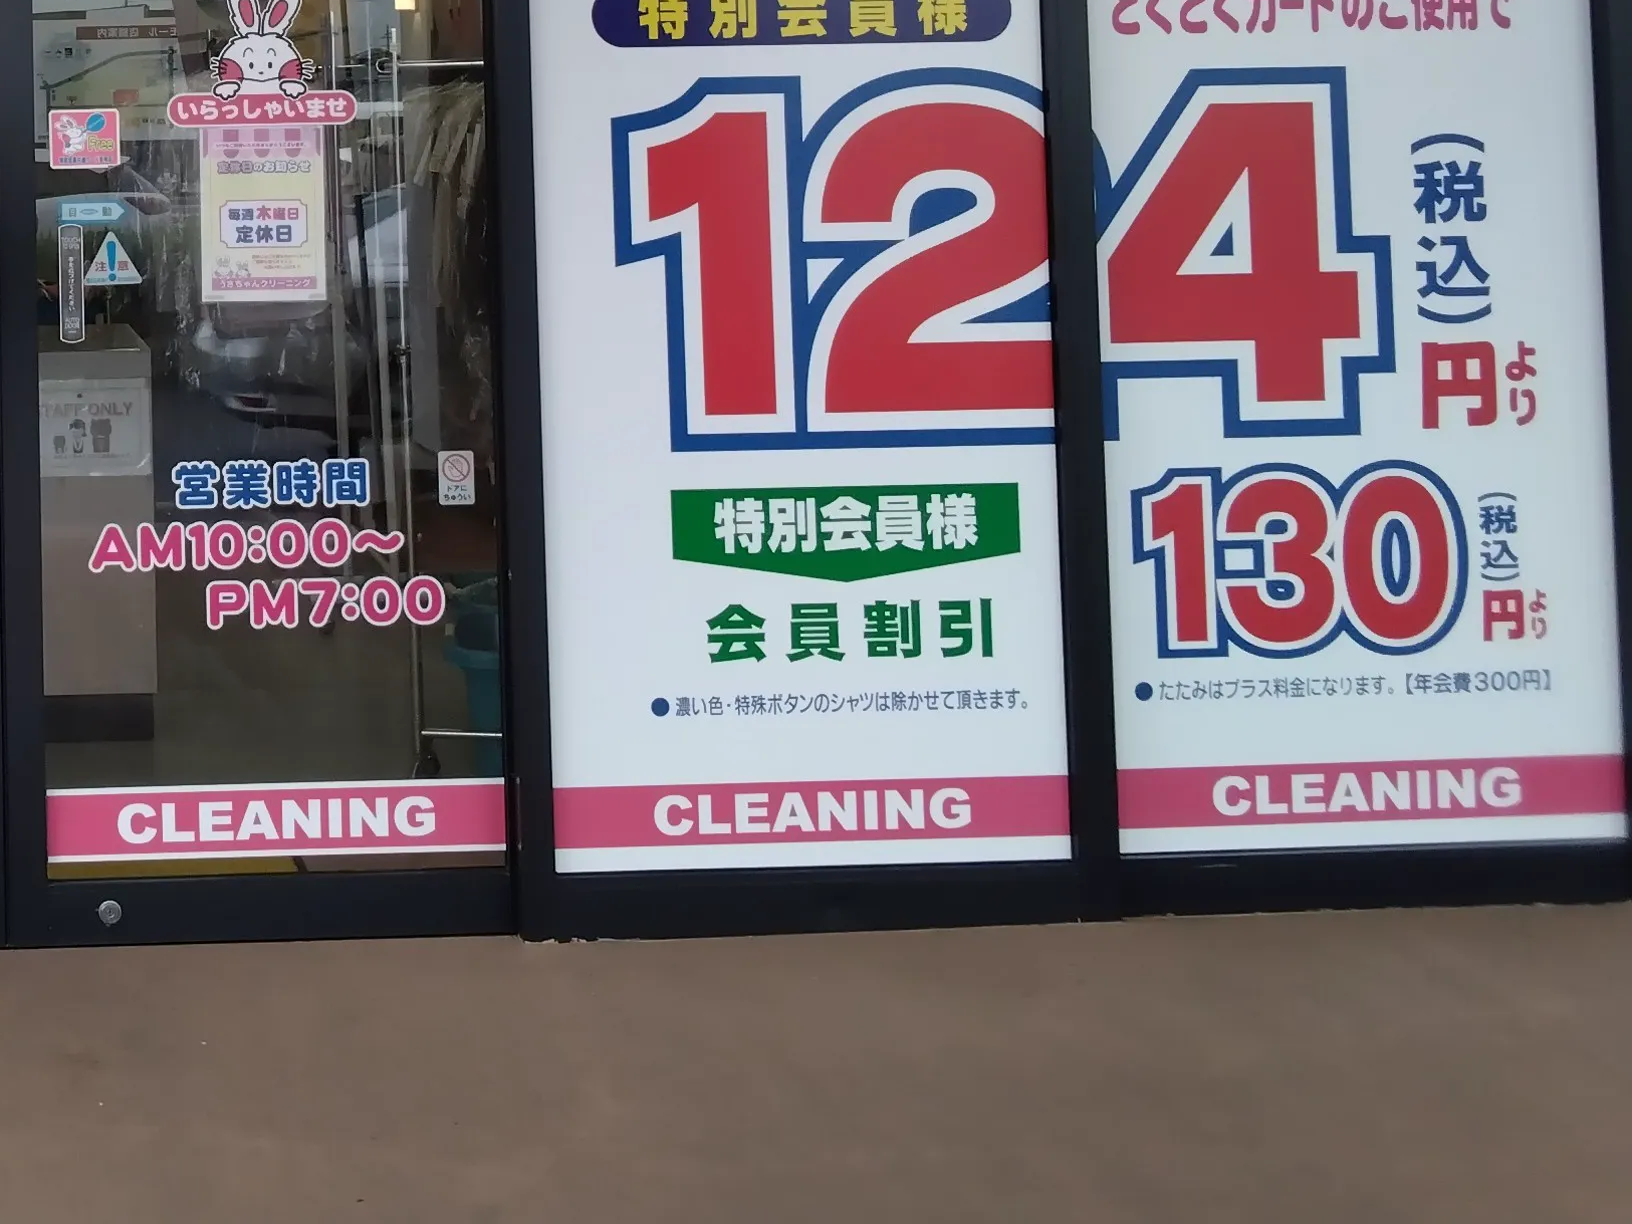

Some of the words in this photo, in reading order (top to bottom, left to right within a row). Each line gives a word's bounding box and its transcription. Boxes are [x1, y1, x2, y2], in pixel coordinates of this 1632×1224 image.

[177, 96, 348, 121] いらっしゃいませ
[87, 135, 114, 151] Free
[217, 159, 311, 174] 定休日のお知らせ
[236, 225, 292, 243] 定休日
[611, 64, 1397, 453] 124
[1410, 133, 1492, 324] (税込)
[1504, 339, 1538, 427] より
[172, 458, 369, 510] 営業時間
[443, 494, 471, 502] ちゅうい
[714, 492, 979, 556] 特別会員様
[1130, 459, 1468, 660] 130
[1478, 492, 1520, 582] (税込)
[1528, 588, 1548, 641] より
[206, 576, 446, 630] PM7:00
[705, 596, 996, 664] 会員割引
[675, 687, 1028, 717] 濃い色・特殊ボタンのシャツは除かせて頂きます。
[653, 787, 972, 836] CLEANING
[1212, 767, 1523, 816] CLEANING
[117, 796, 437, 845] CLEANING
